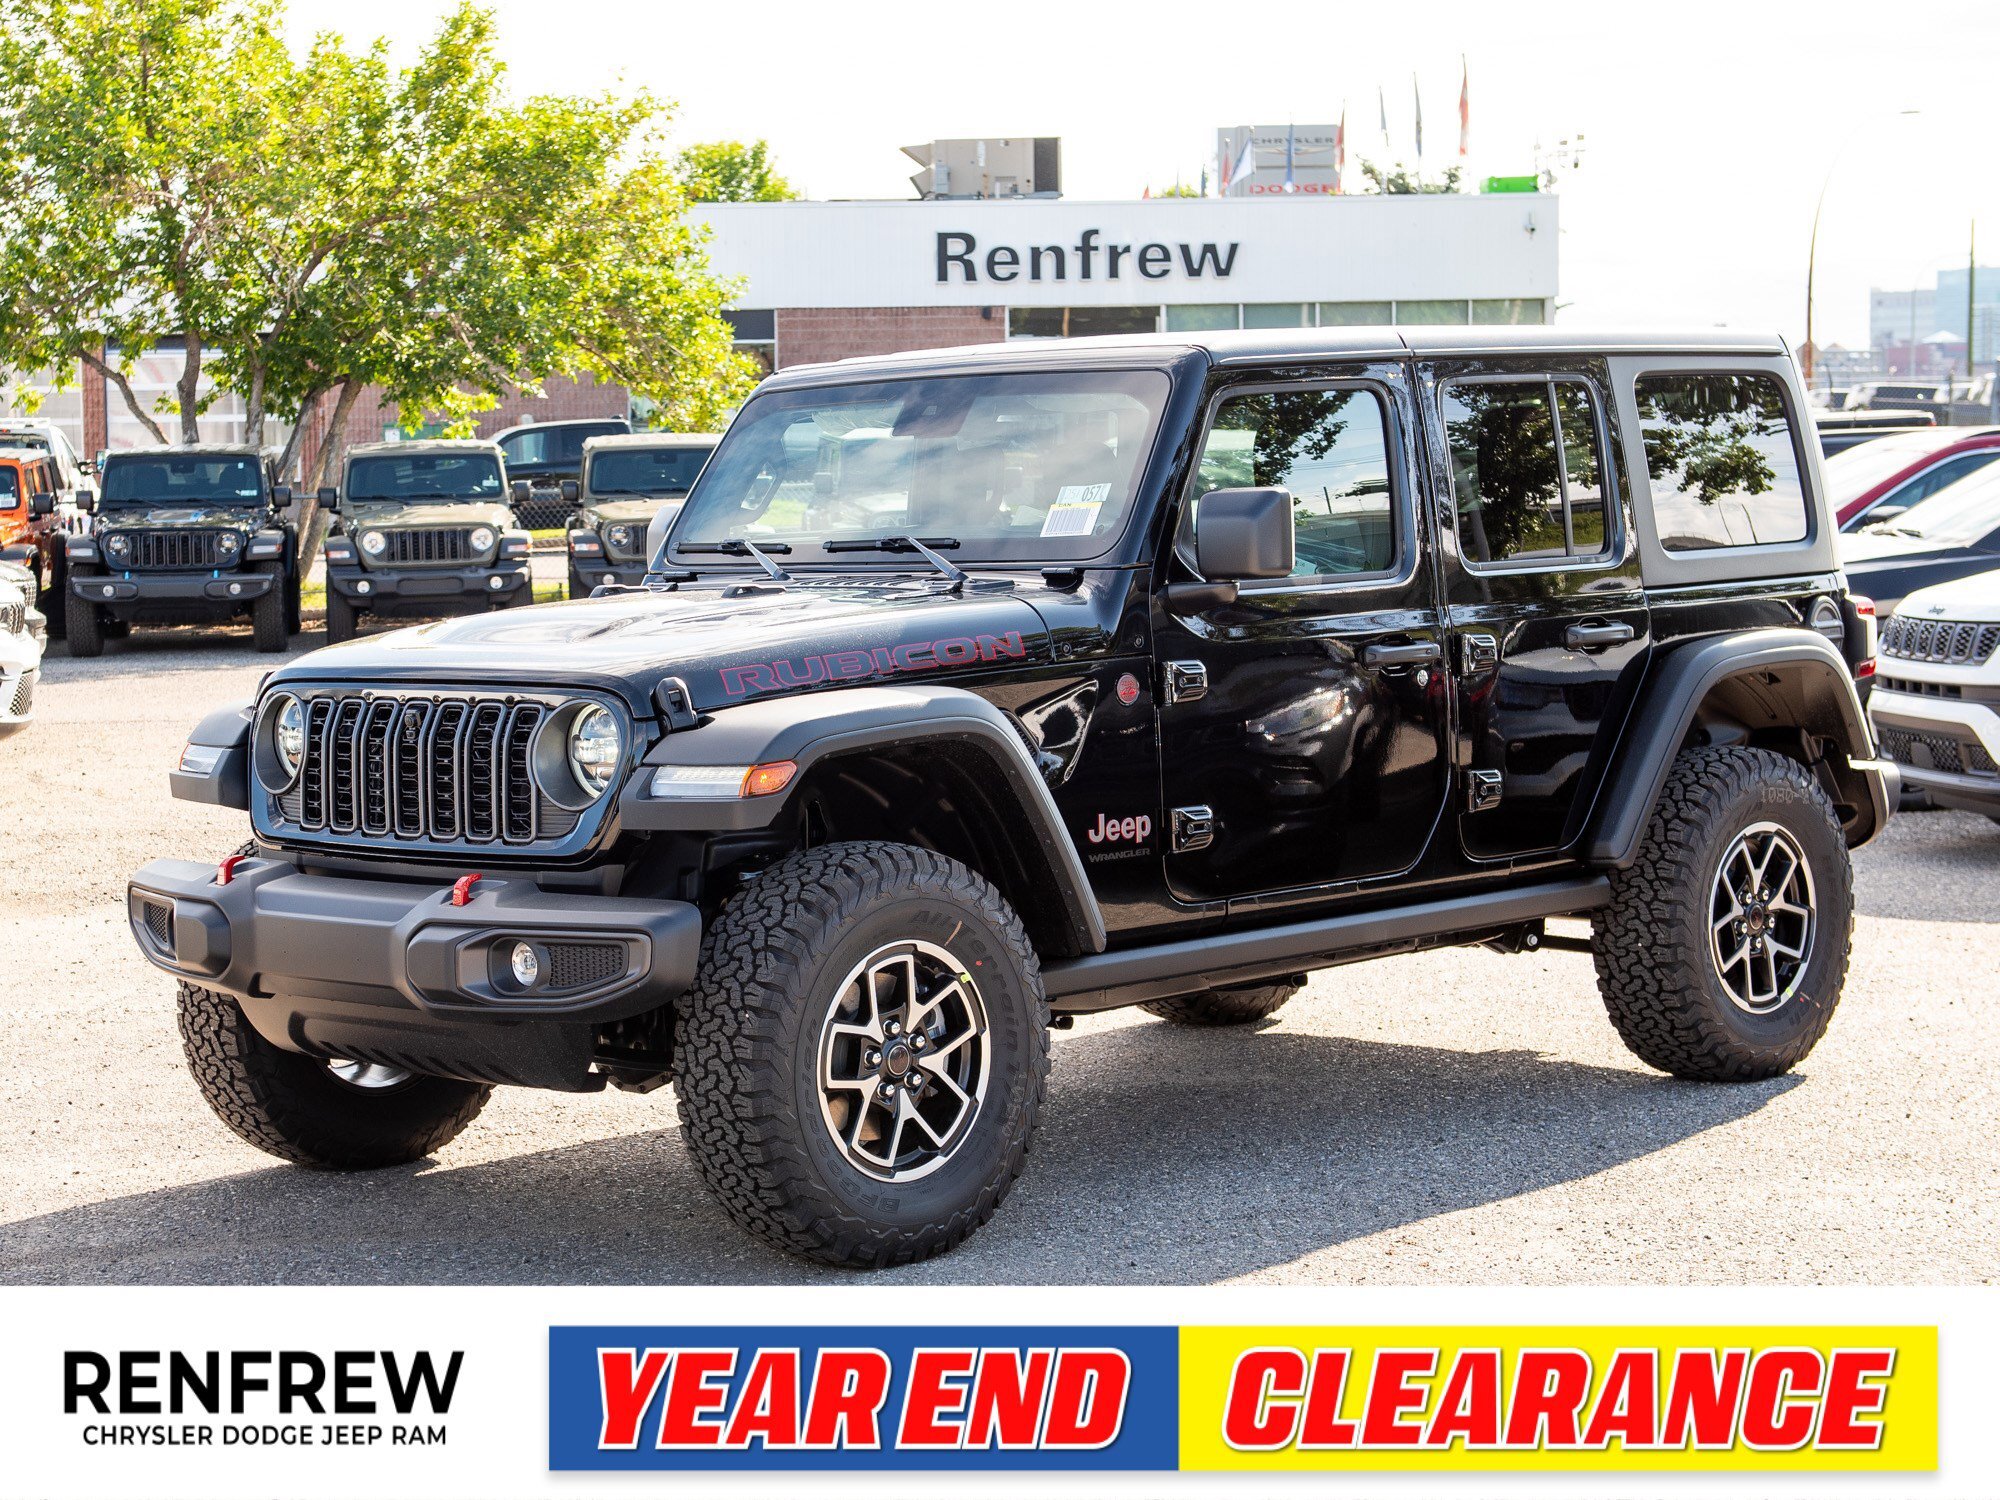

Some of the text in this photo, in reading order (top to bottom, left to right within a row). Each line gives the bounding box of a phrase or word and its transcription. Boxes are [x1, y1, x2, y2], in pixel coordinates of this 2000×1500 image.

[937, 229, 1239, 282] Renfrew
[720, 631, 1026, 695] RUBICON
[1087, 813, 1152, 844] Jeep
[1087, 847, 1152, 863] WRANGLER
